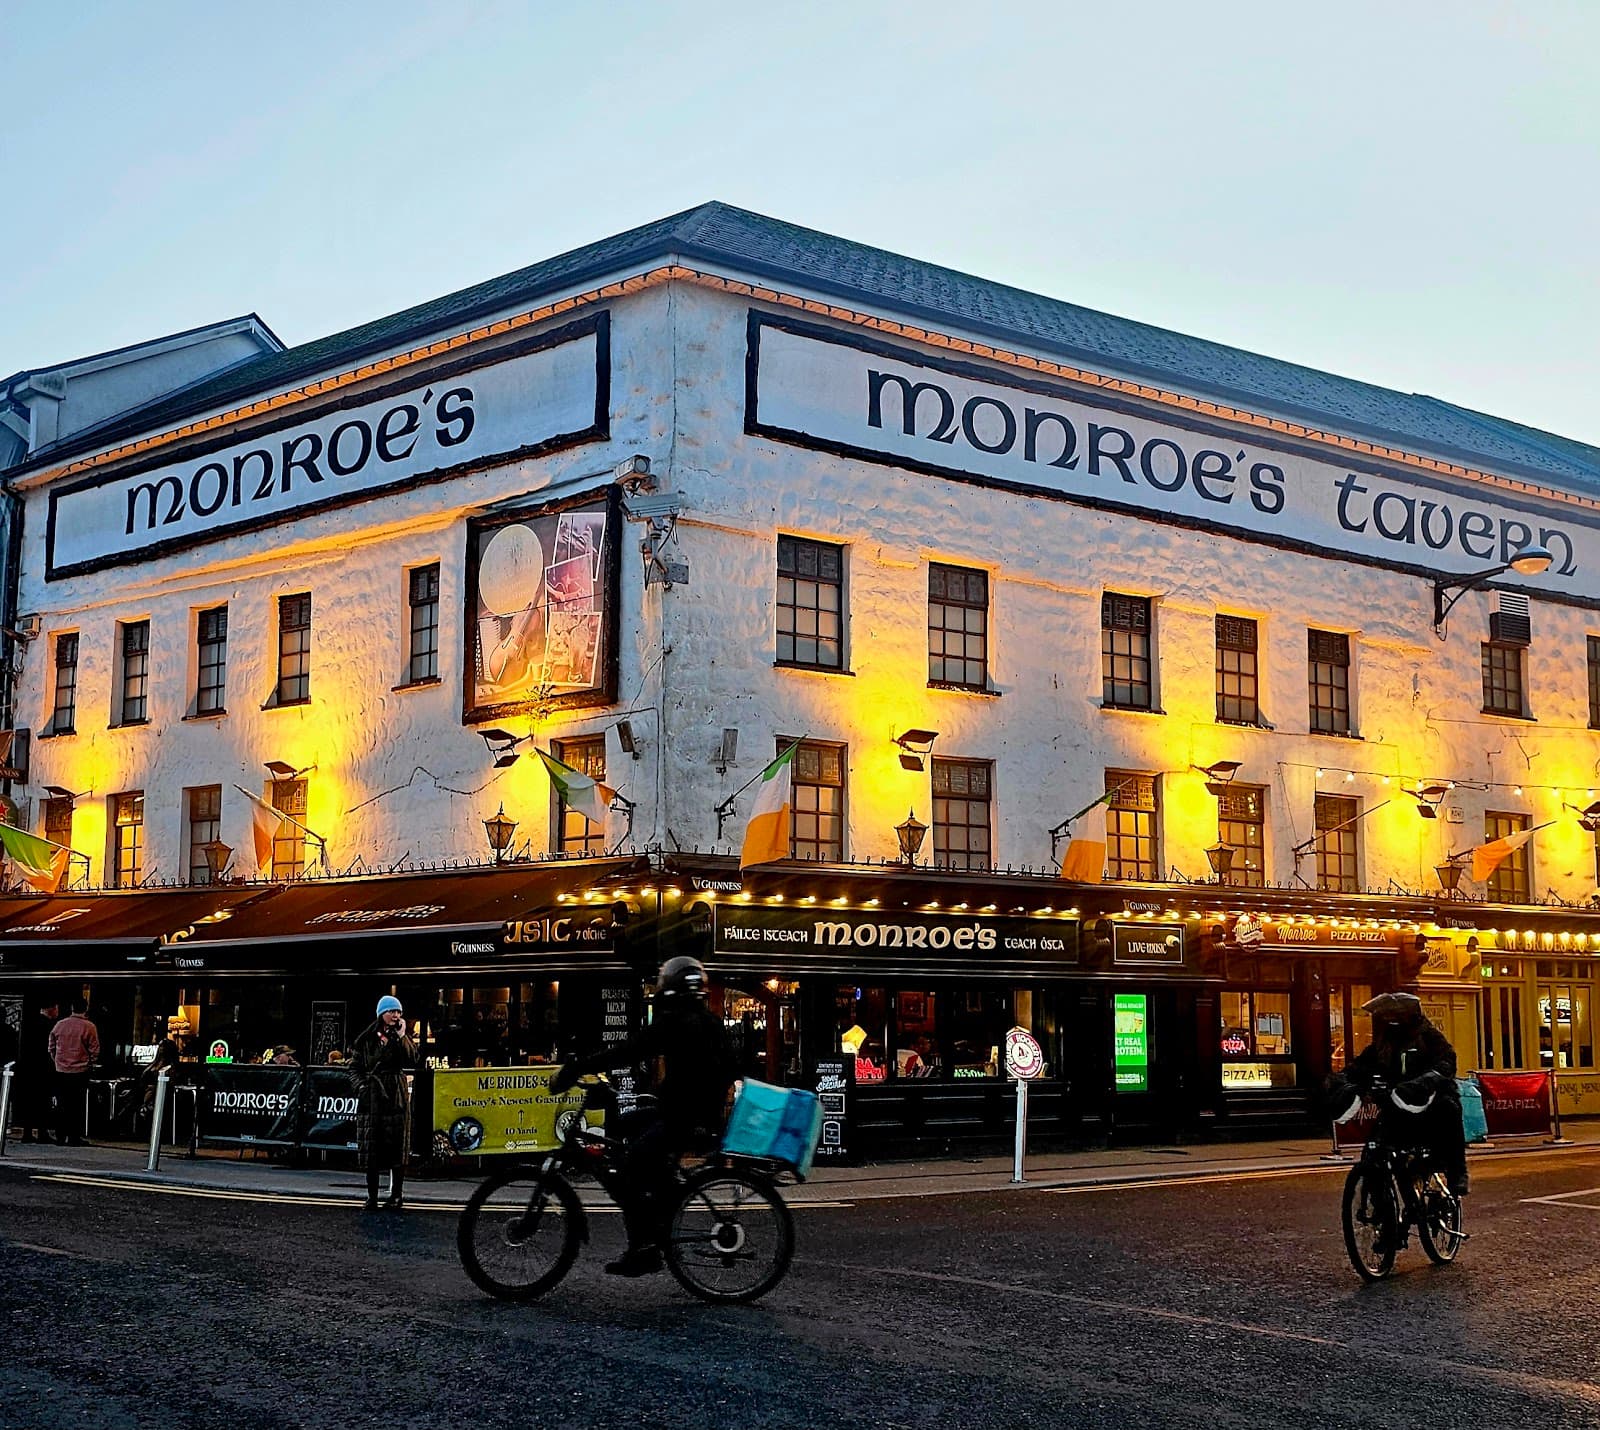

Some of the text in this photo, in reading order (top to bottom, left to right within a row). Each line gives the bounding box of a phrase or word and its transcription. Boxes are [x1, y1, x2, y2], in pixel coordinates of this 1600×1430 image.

[701, 880, 741, 891] GUINNESS
[1330, 931, 1358, 941] PIZZA
[1360, 932, 1386, 942] PIZZA
[458, 943, 495, 953] GUINNESS
[1005, 938, 1036, 950] TEACH
[1222, 1039, 1246, 1050] PIZZA
[1223, 1070, 1255, 1080] PIZZA
[453, 1096, 496, 1108] Galway's
[500, 1096, 533, 1106] Newest
[1486, 1099, 1514, 1110] PIZZA
